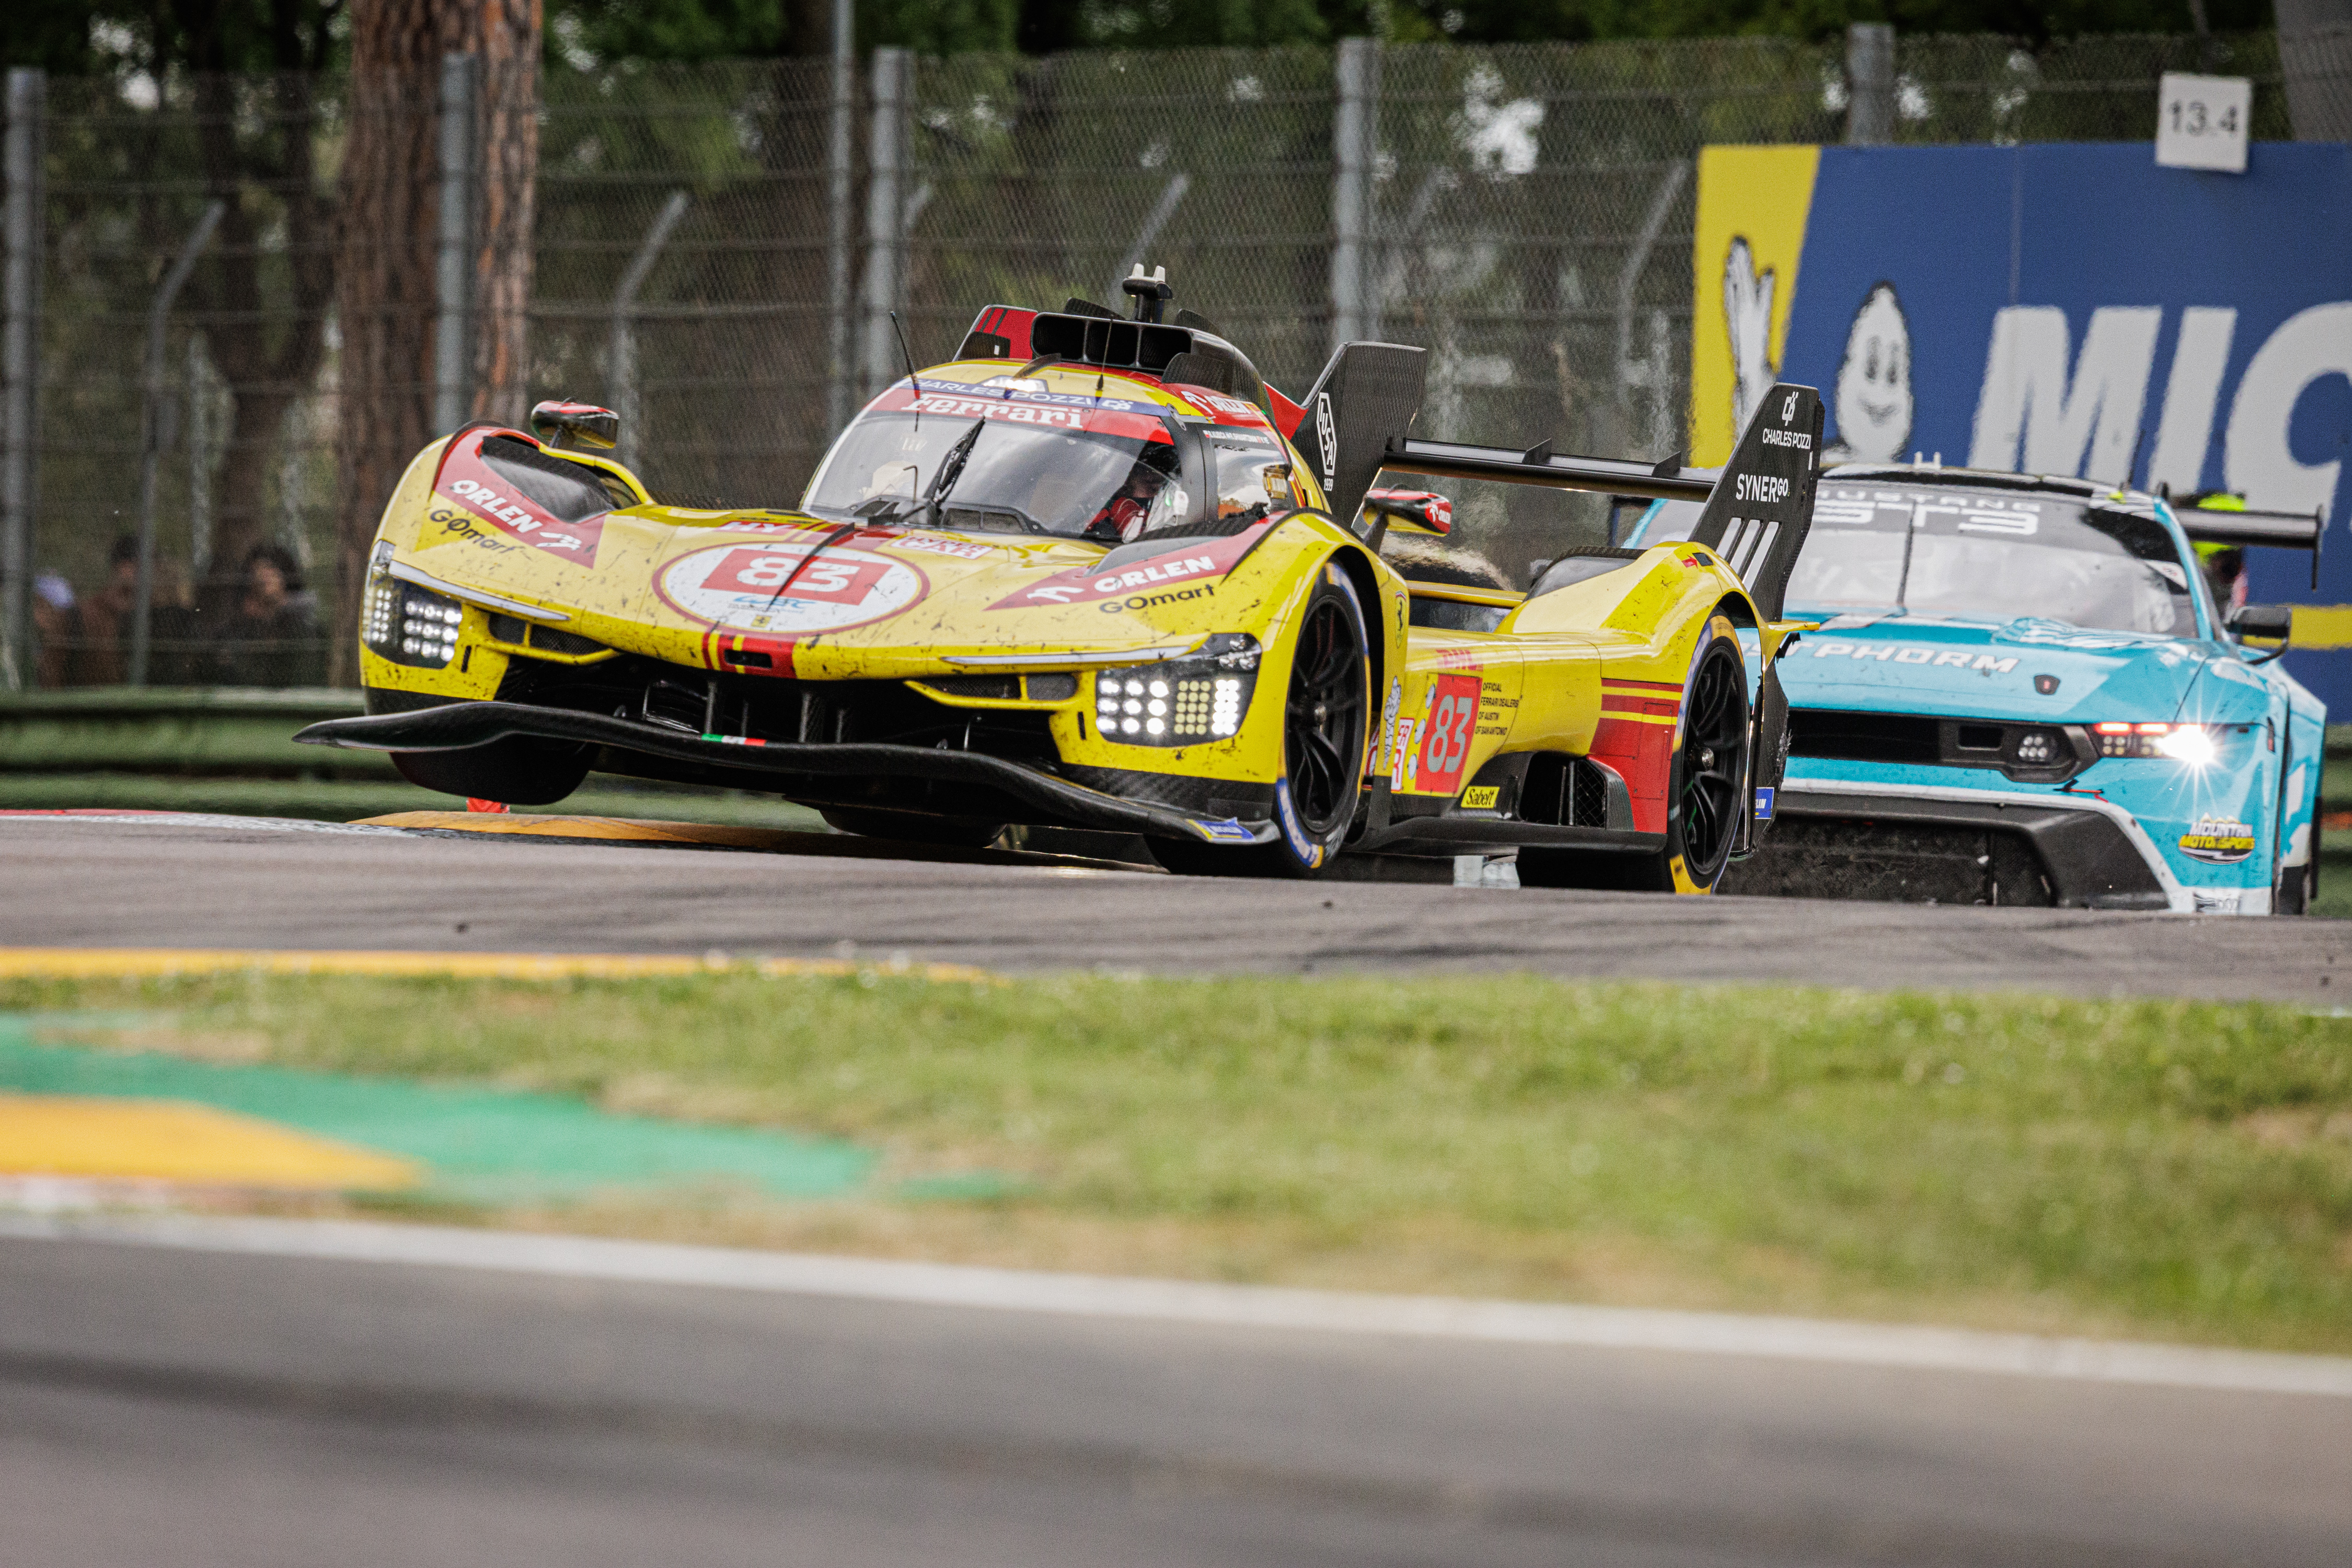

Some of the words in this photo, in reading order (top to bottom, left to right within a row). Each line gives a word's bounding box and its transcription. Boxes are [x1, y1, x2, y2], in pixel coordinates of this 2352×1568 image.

[2169, 99, 2238, 137] 13.4
[902, 379, 1004, 397] CHARLES
[1011, 391, 1092, 406] POZZI
[901, 393, 1083, 429] Ferrari
[1204, 395, 1252, 414] ORLEN
[1967, 300, 2352, 515] MIC
[1762, 428, 1793, 447] CHARLES
[1792, 432, 1812, 450] POZZI
[1323, 478, 1333, 492] 1939
[451, 480, 543, 533] ORLEN
[1438, 509, 1451, 525] ORLEN
[899, 540, 977, 557] CAR
[908, 537, 986, 550] HYPER
[736, 557, 860, 592] 83
[1094, 556, 1216, 593] ORLEN
[1099, 584, 1214, 614] GOmart
[1482, 683, 1502, 692] OFFICIAL
[1480, 696, 1498, 707] FERRARI
[1499, 698, 1519, 708] DEALERS
[1478, 711, 1484, 720] OF
[1484, 712, 1500, 721] AUSTIN
[1427, 694, 1473, 773] 83
[1475, 725, 1481, 734] OF
[1466, 789, 1495, 805] Sabelt
